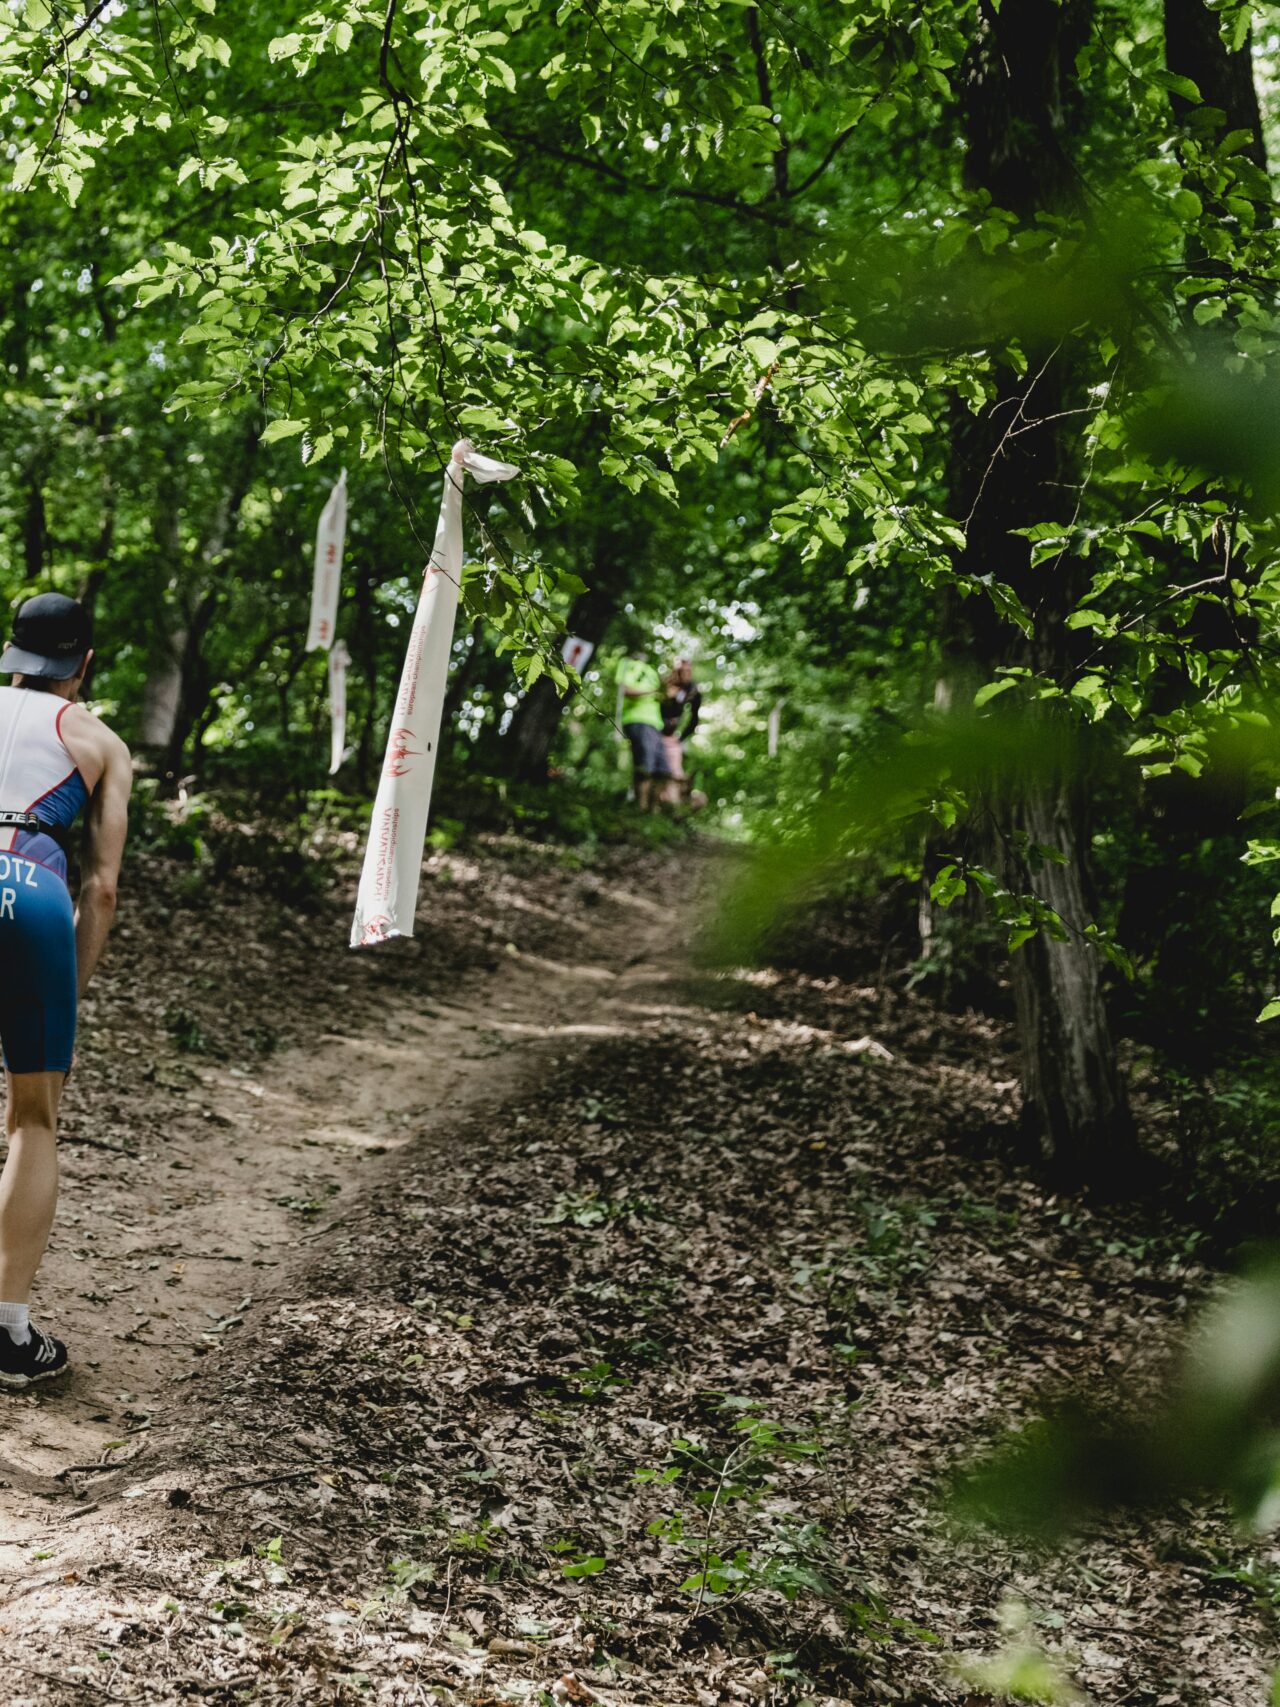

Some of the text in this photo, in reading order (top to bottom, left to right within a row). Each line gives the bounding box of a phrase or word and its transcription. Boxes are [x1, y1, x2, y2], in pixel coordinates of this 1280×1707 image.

[407, 625, 427, 716] european championships
[383, 808, 400, 901] european championships
